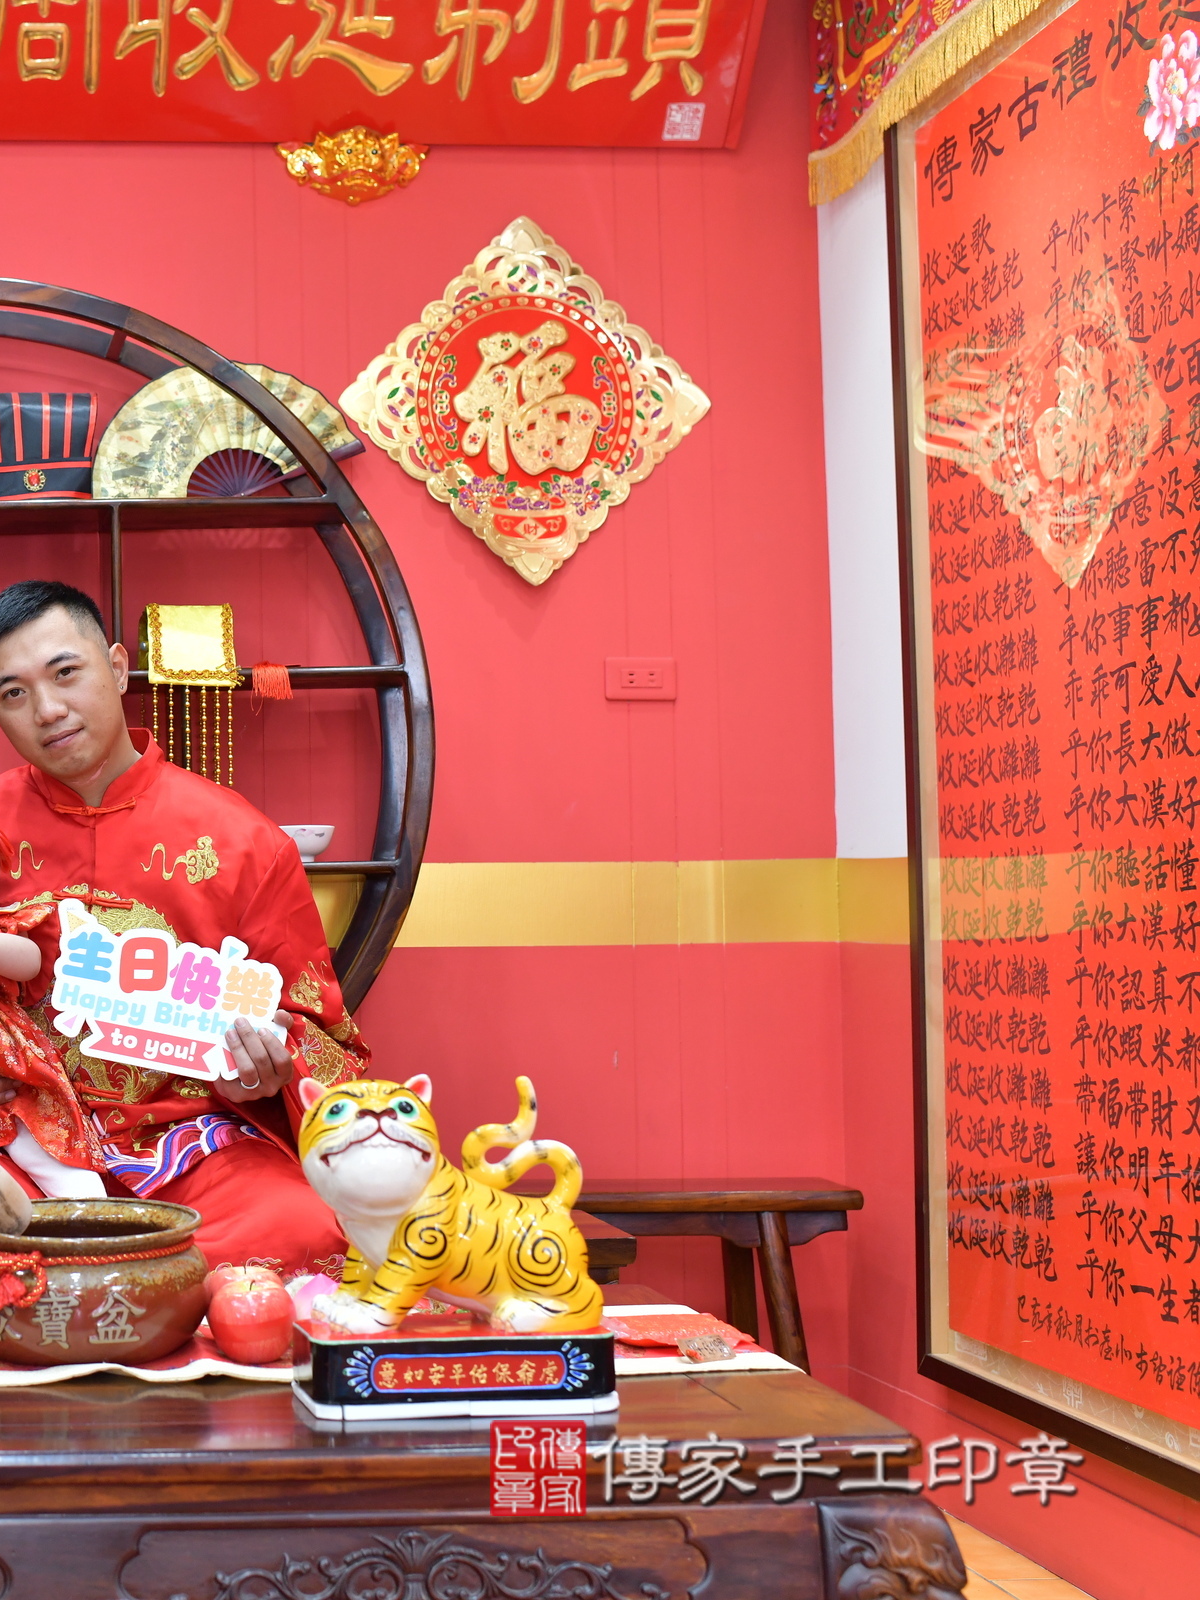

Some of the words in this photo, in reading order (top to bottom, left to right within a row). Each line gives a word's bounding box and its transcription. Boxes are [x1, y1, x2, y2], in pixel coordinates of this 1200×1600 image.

[453, 320, 602, 476] 福
[62, 931, 274, 1017] 生日快樂
[59, 982, 147, 1026] Happy
[154, 1001, 278, 1038] Birth
[110, 1028, 138, 1048] to
[143, 1038, 197, 1063] you!
